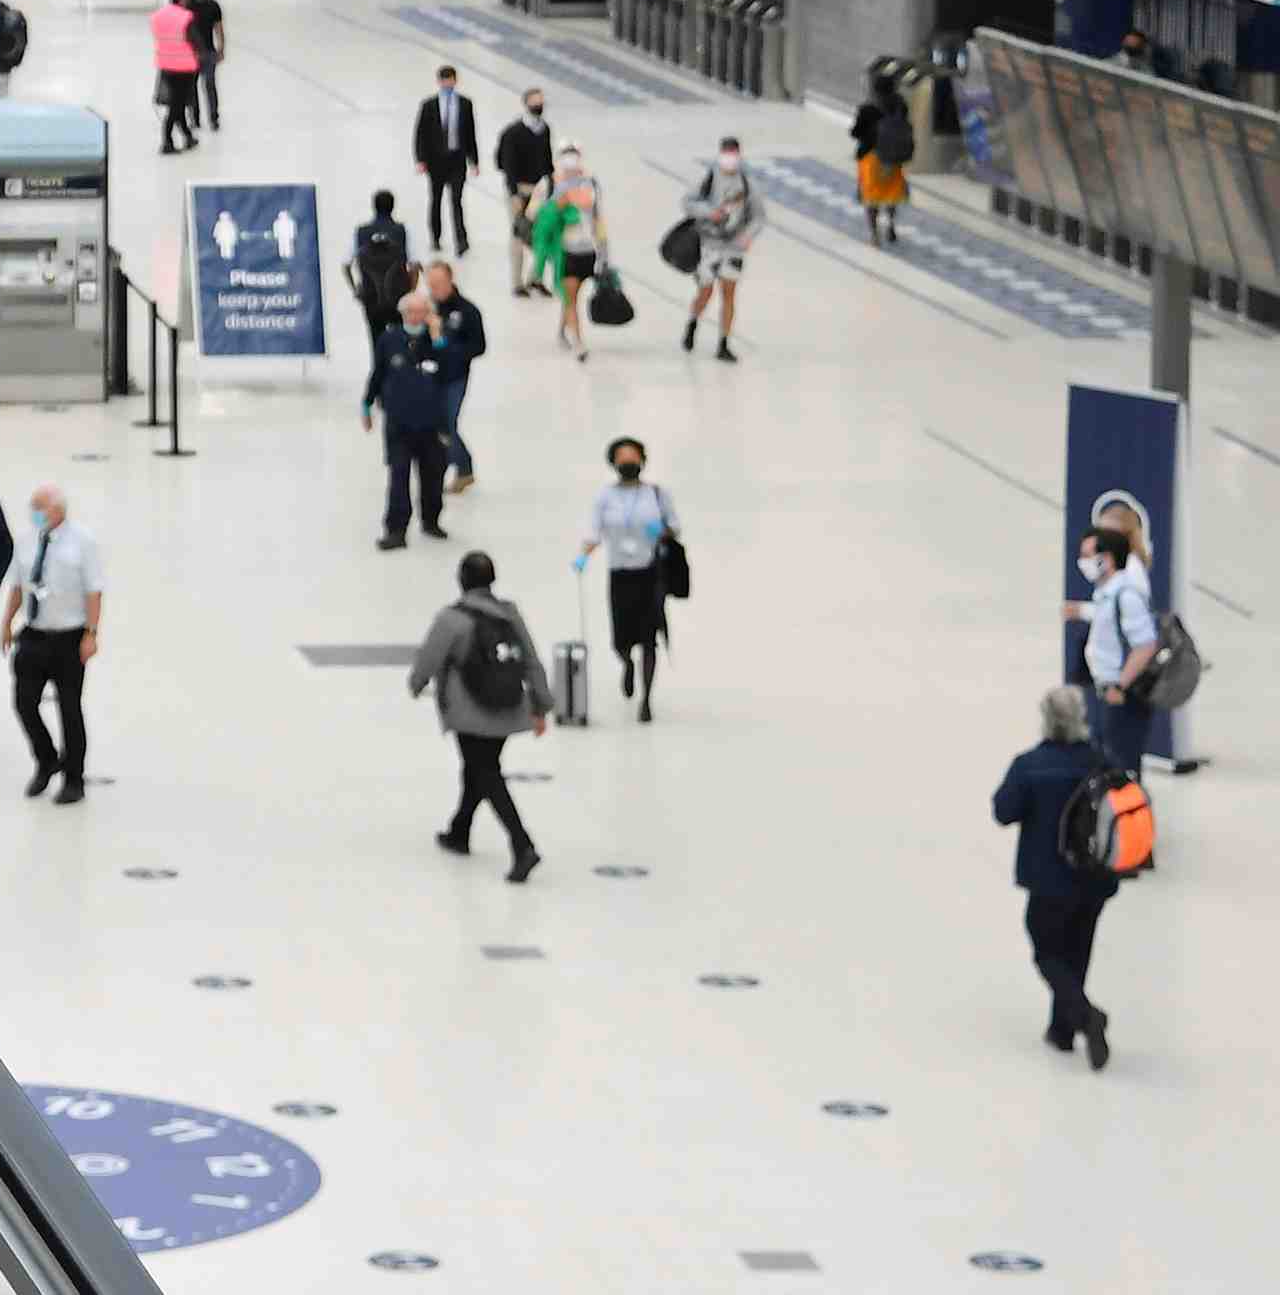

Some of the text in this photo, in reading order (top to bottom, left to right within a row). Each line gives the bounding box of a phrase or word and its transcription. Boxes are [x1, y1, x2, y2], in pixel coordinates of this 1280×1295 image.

[229, 268, 288, 286] Please
[218, 292, 302, 310] keep your
[224, 312, 297, 330] distance
[43, 1094, 115, 1121] 10
[205, 1151, 272, 1178] 12
